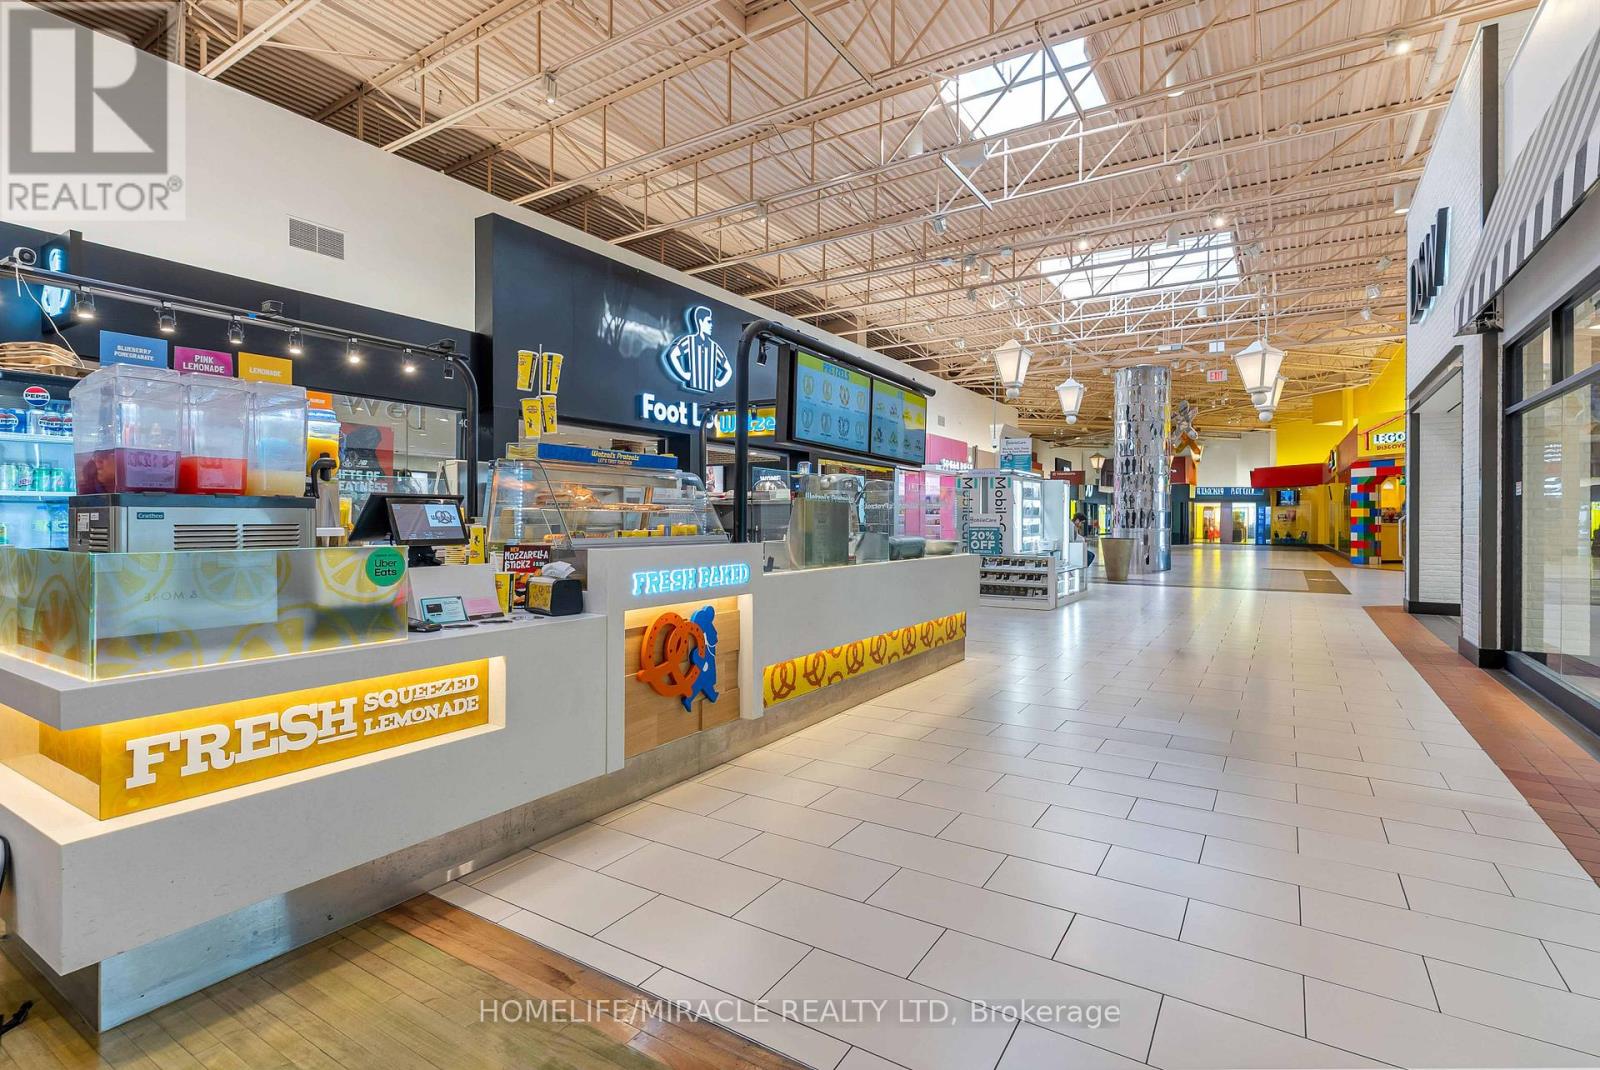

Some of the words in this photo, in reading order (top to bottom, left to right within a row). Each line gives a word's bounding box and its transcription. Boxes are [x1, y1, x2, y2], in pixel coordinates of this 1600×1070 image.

[194, 354, 214, 364] PINK
[182, 362, 225, 374] LEMONADE
[249, 366, 283, 377] LEMONADE
[1210, 371, 1223, 381] EXIT
[643, 392, 688, 425] Foot
[719, 411, 776, 433] Wtze
[1373, 431, 1406, 444] LEGO
[970, 531, 995, 541] 20%
[970, 540, 996, 550] OFF
[504, 550, 549, 561] MOZZARELLA
[504, 560, 531, 570] STICKZ
[374, 568, 397, 577] Eats
[631, 569, 698, 596] FRESH
[698, 562, 751, 588] BAKED
[363, 674, 479, 713] SQUEEZED
[363, 695, 479, 736] LEMONADE
[125, 696, 358, 789] FRESH
